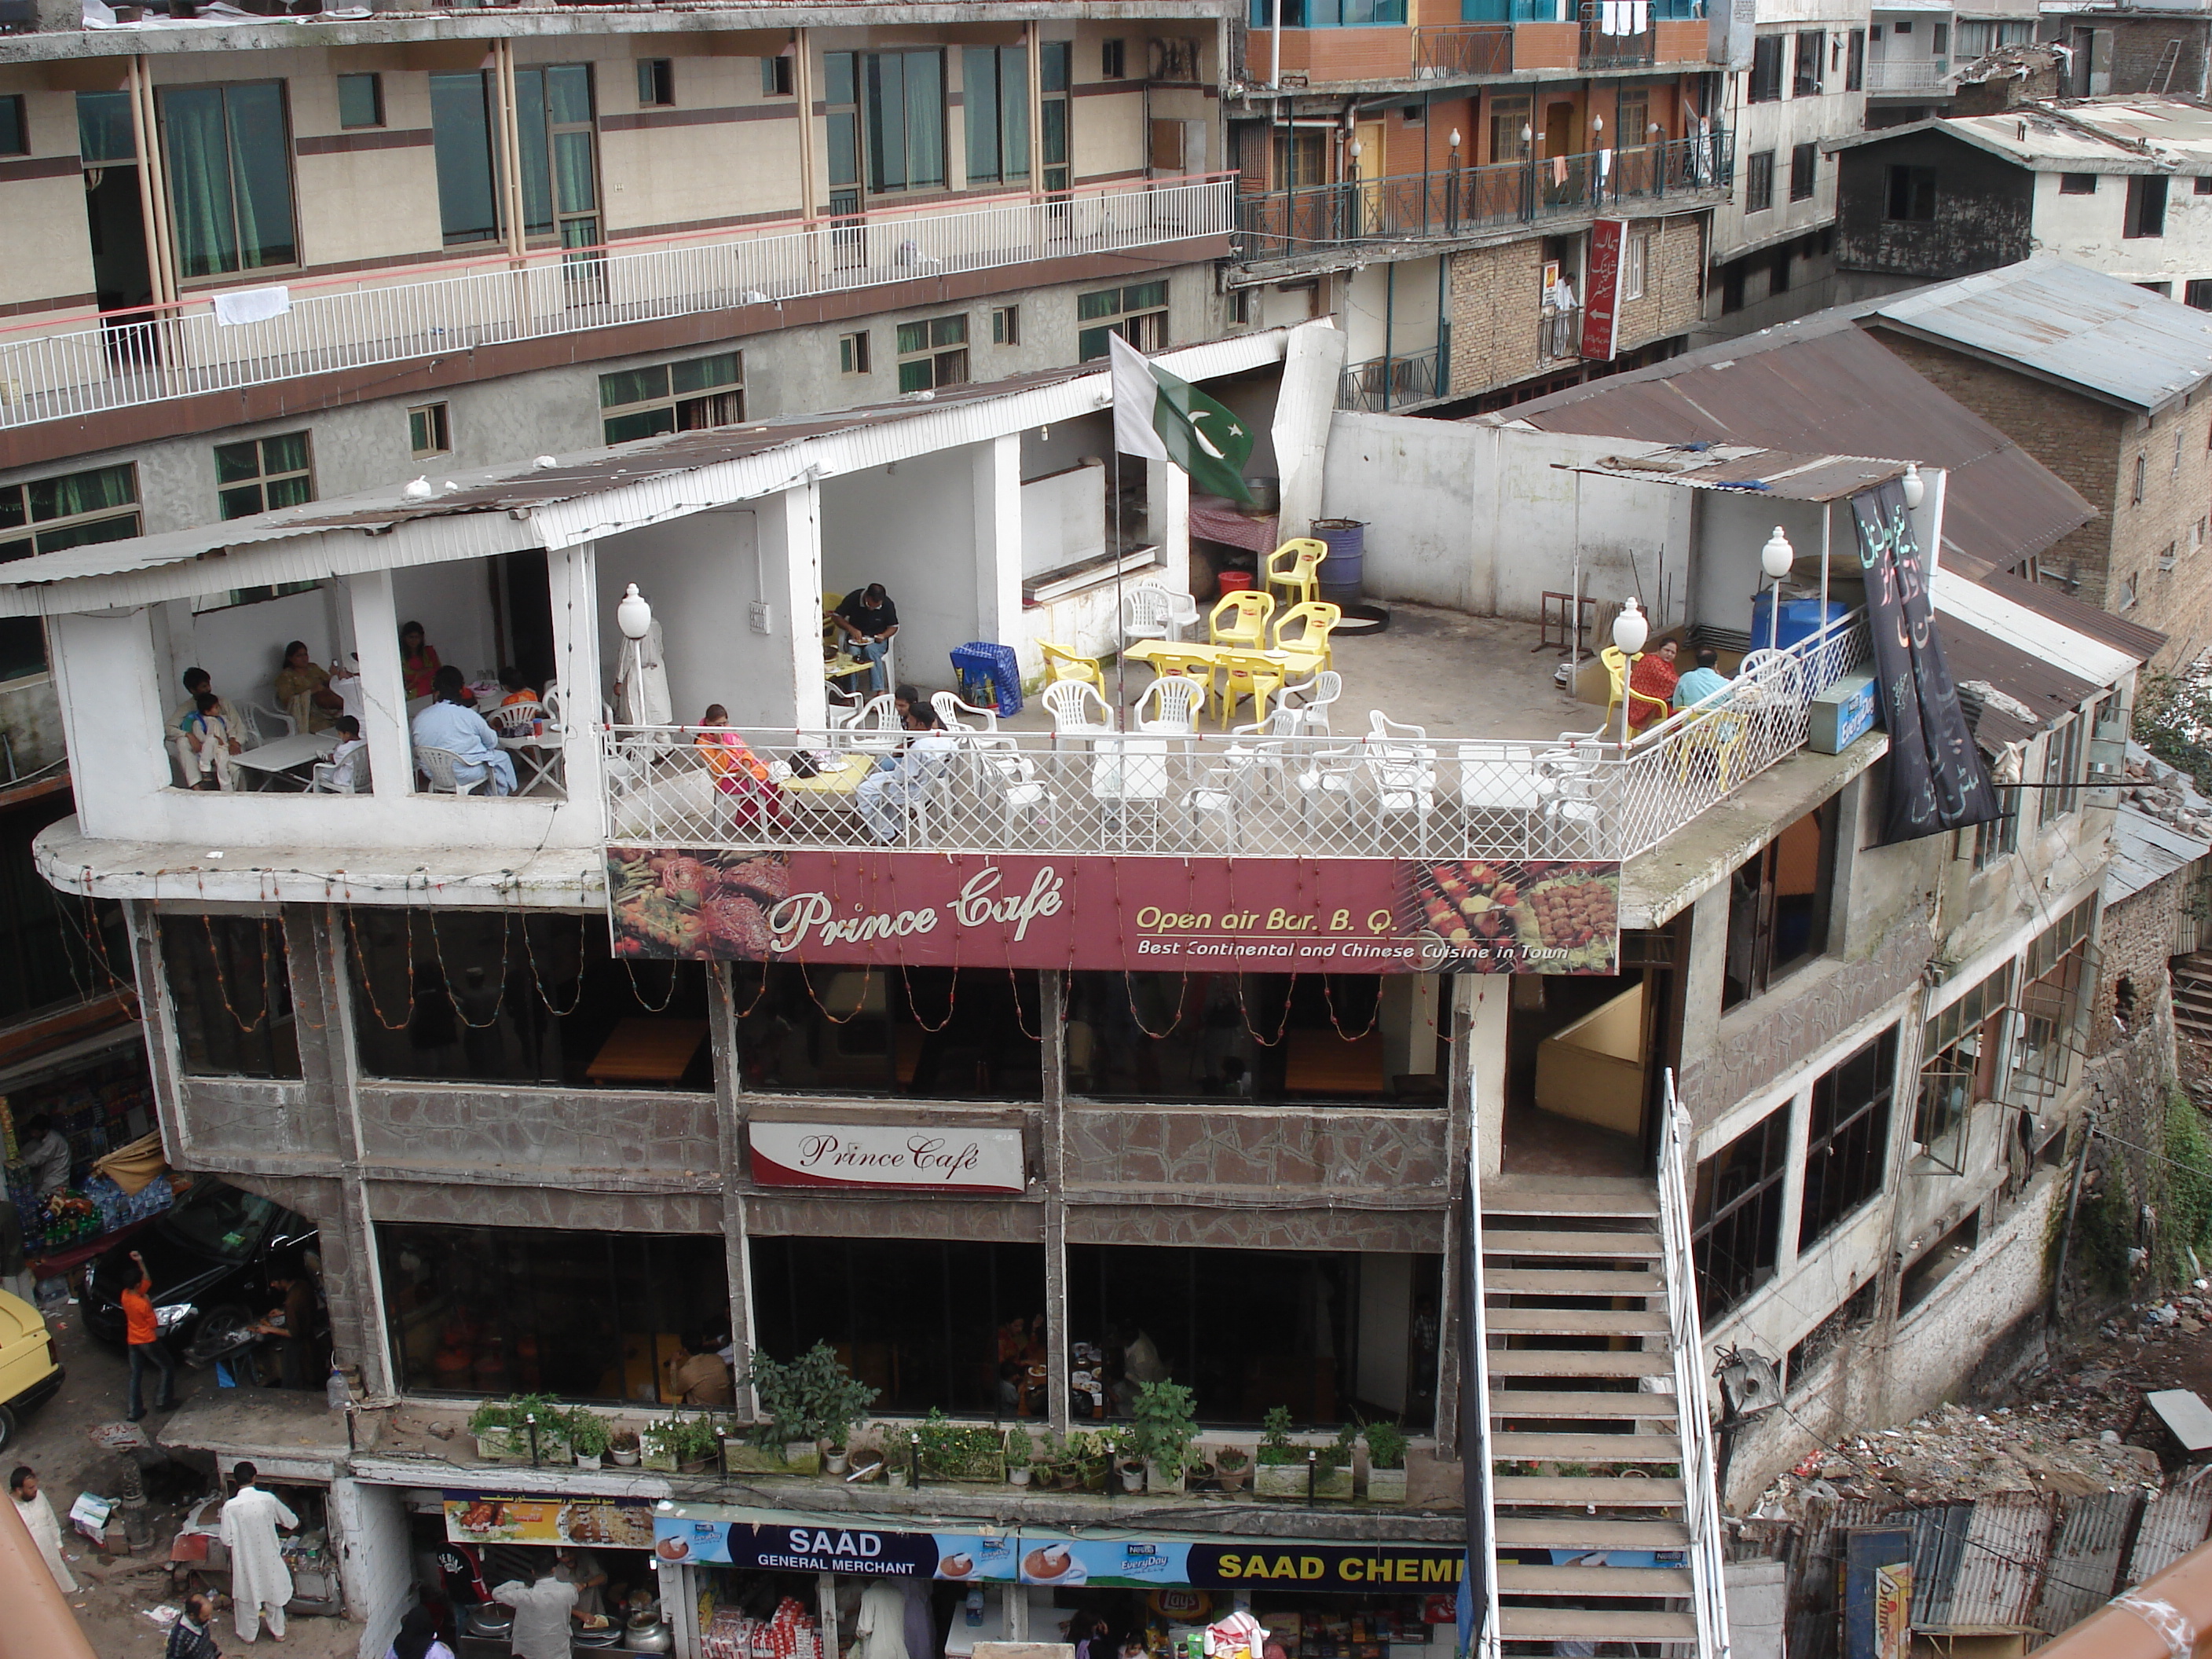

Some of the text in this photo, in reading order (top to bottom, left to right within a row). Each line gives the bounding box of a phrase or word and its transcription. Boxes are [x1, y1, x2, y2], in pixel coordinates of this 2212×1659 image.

[770, 866, 1064, 952] Prince Café
[1137, 906, 1398, 935] Open air Bar. B. Q.
[1138, 939, 1569, 960] Best Continental and Chinese Cuisine in Town
[799, 1134, 980, 1180] Prince Café
[789, 1529, 881, 1557] SAAD
[758, 1555, 915, 1574] GENERAL MERCHANT
[1121, 1556, 1168, 1570] EveryDay
[1218, 1555, 1325, 1580] SAAD
